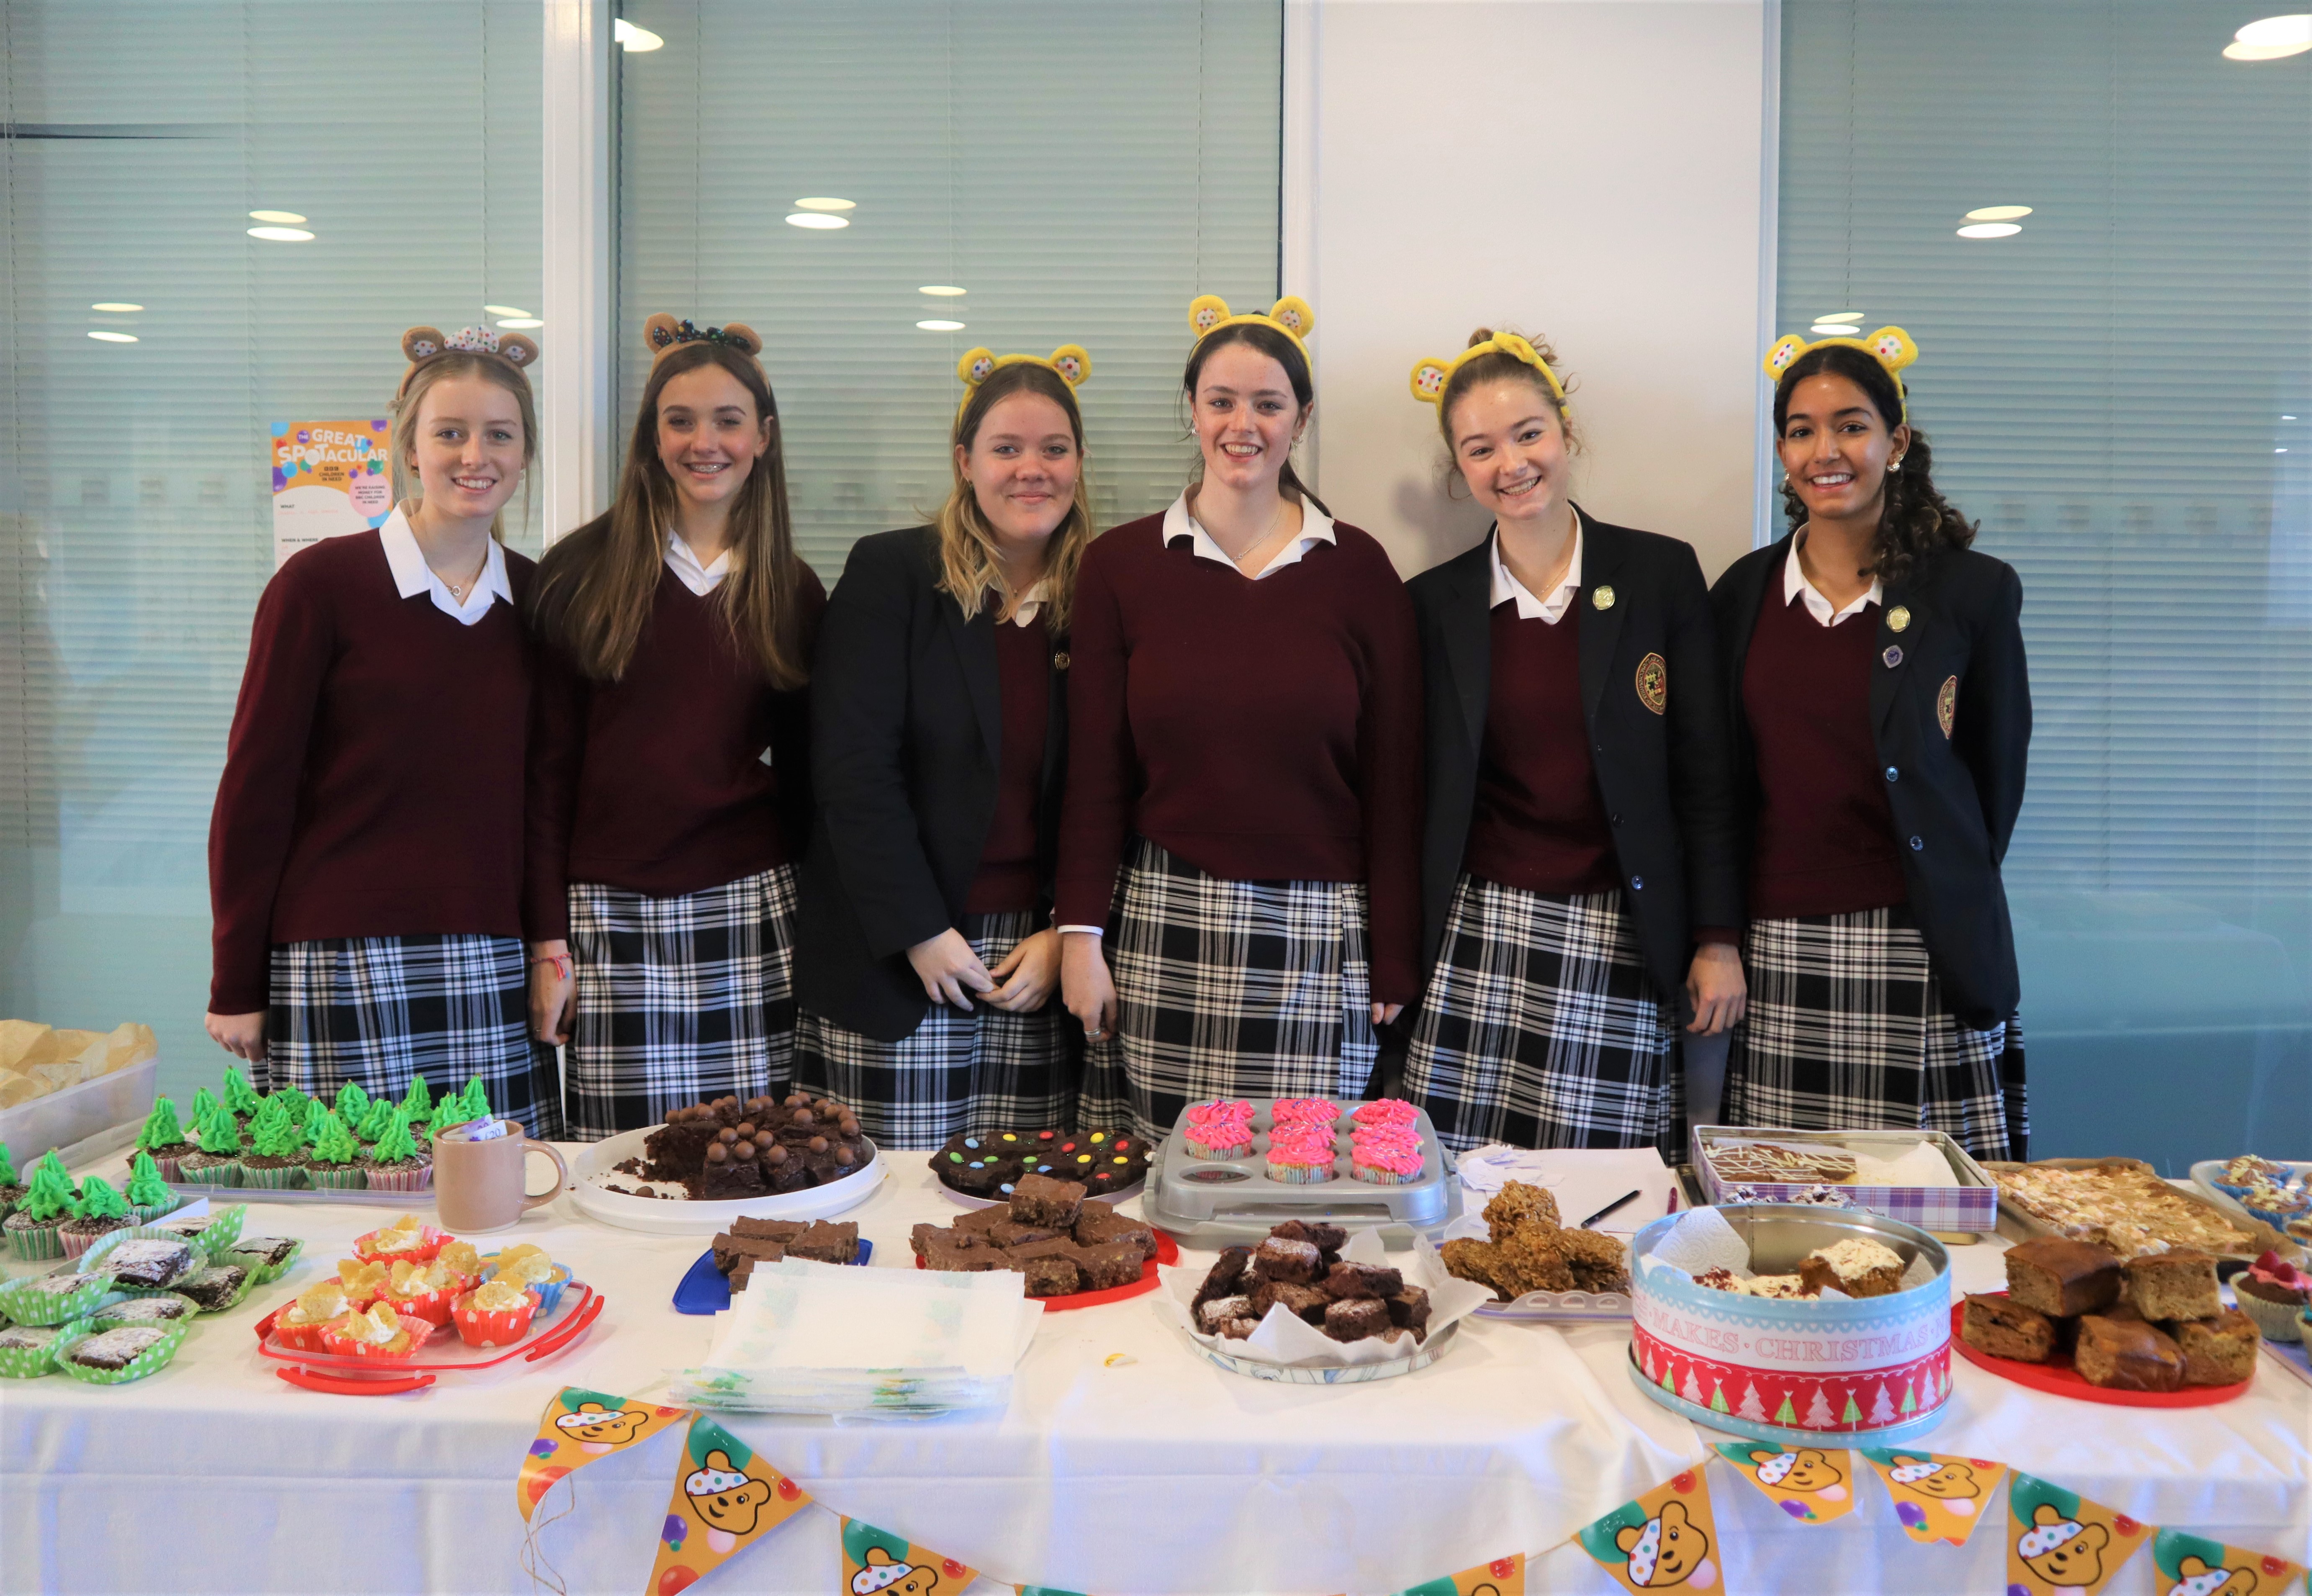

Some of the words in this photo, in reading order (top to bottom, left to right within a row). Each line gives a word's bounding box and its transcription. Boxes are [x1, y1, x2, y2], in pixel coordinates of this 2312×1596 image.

[312, 428, 365, 447] GREAT
[485, 1128, 501, 1140] £20
[1654, 1308, 1739, 1354] MAKES
[1755, 1324, 1928, 1362] CHRISTMAS
